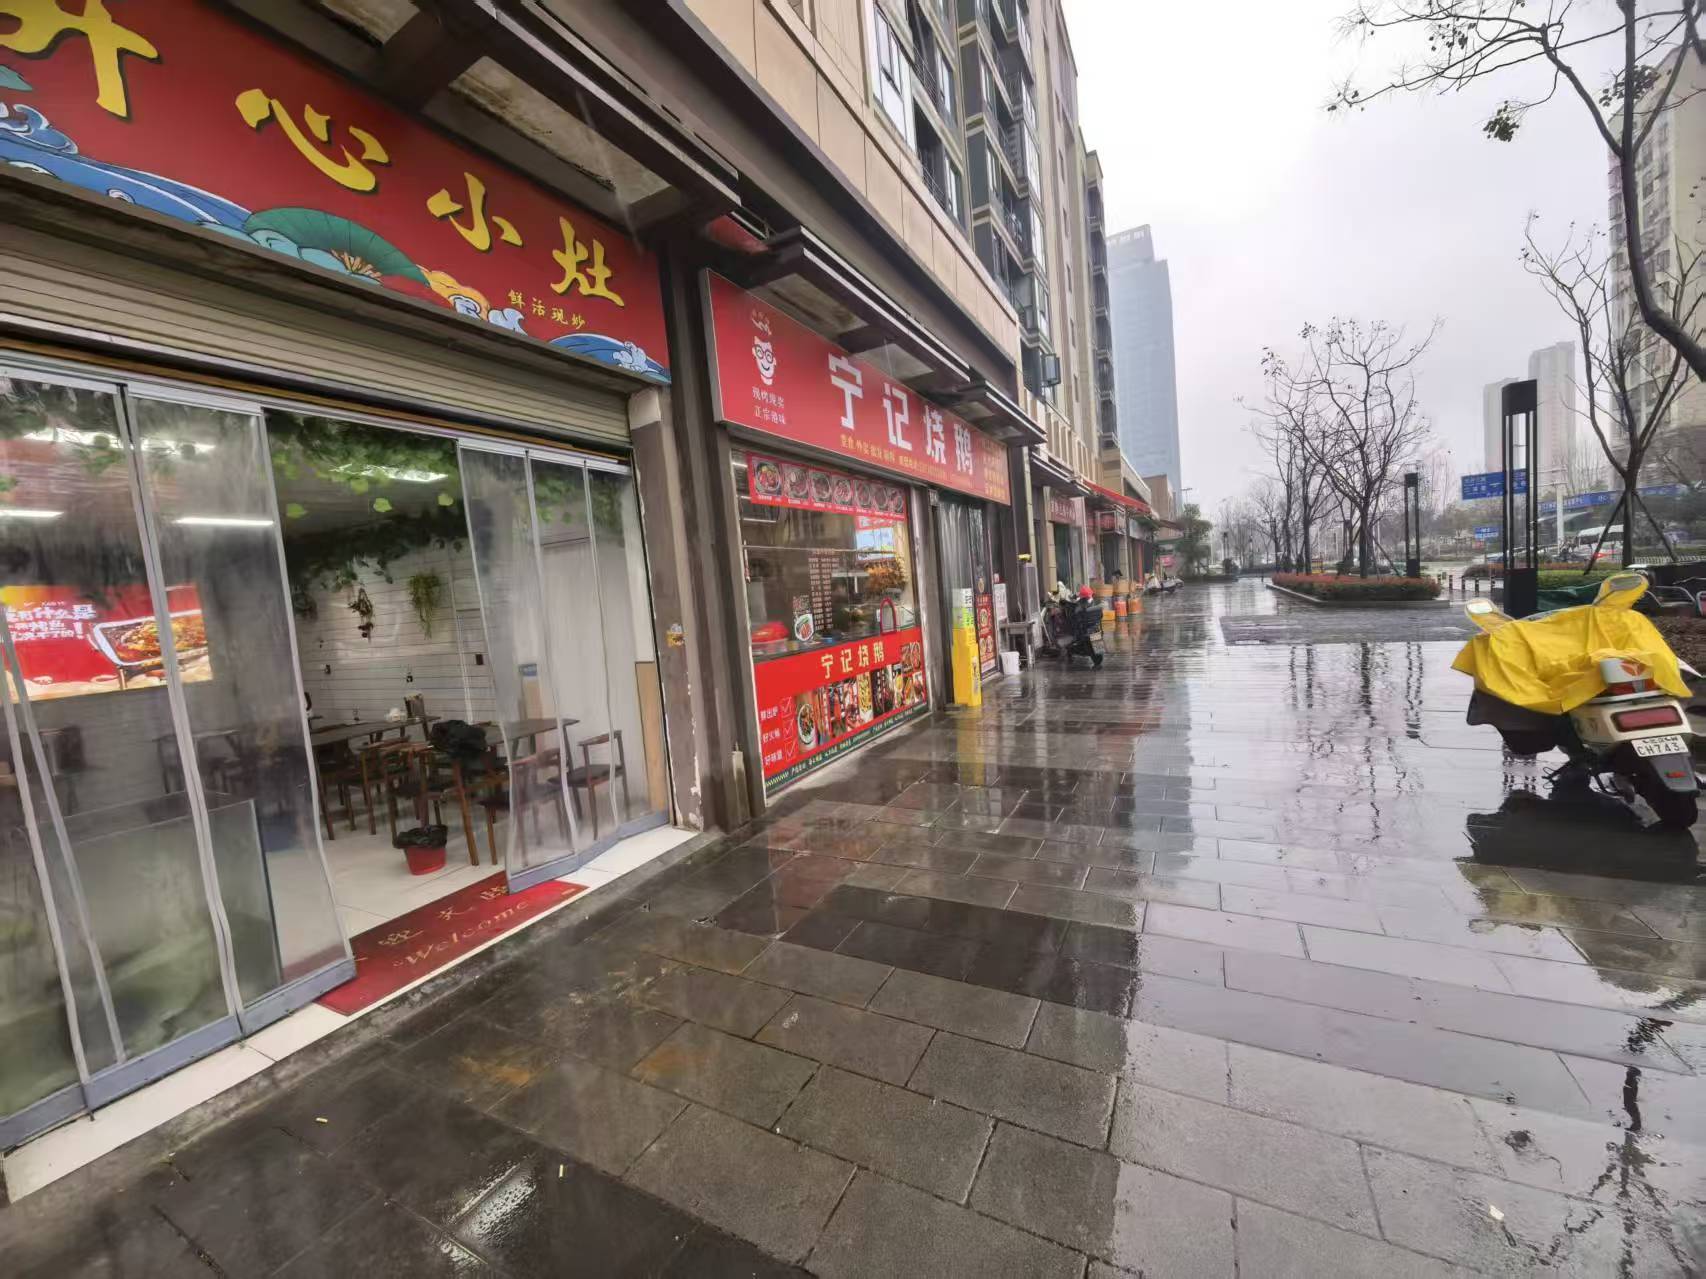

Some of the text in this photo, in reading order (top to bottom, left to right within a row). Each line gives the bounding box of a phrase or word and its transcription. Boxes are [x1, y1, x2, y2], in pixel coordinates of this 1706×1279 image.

[828, 352, 974, 477] 宁记烧鹅
[820, 640, 885, 680] 宁记烧鹅
[400, 900, 529, 966] Welcome
